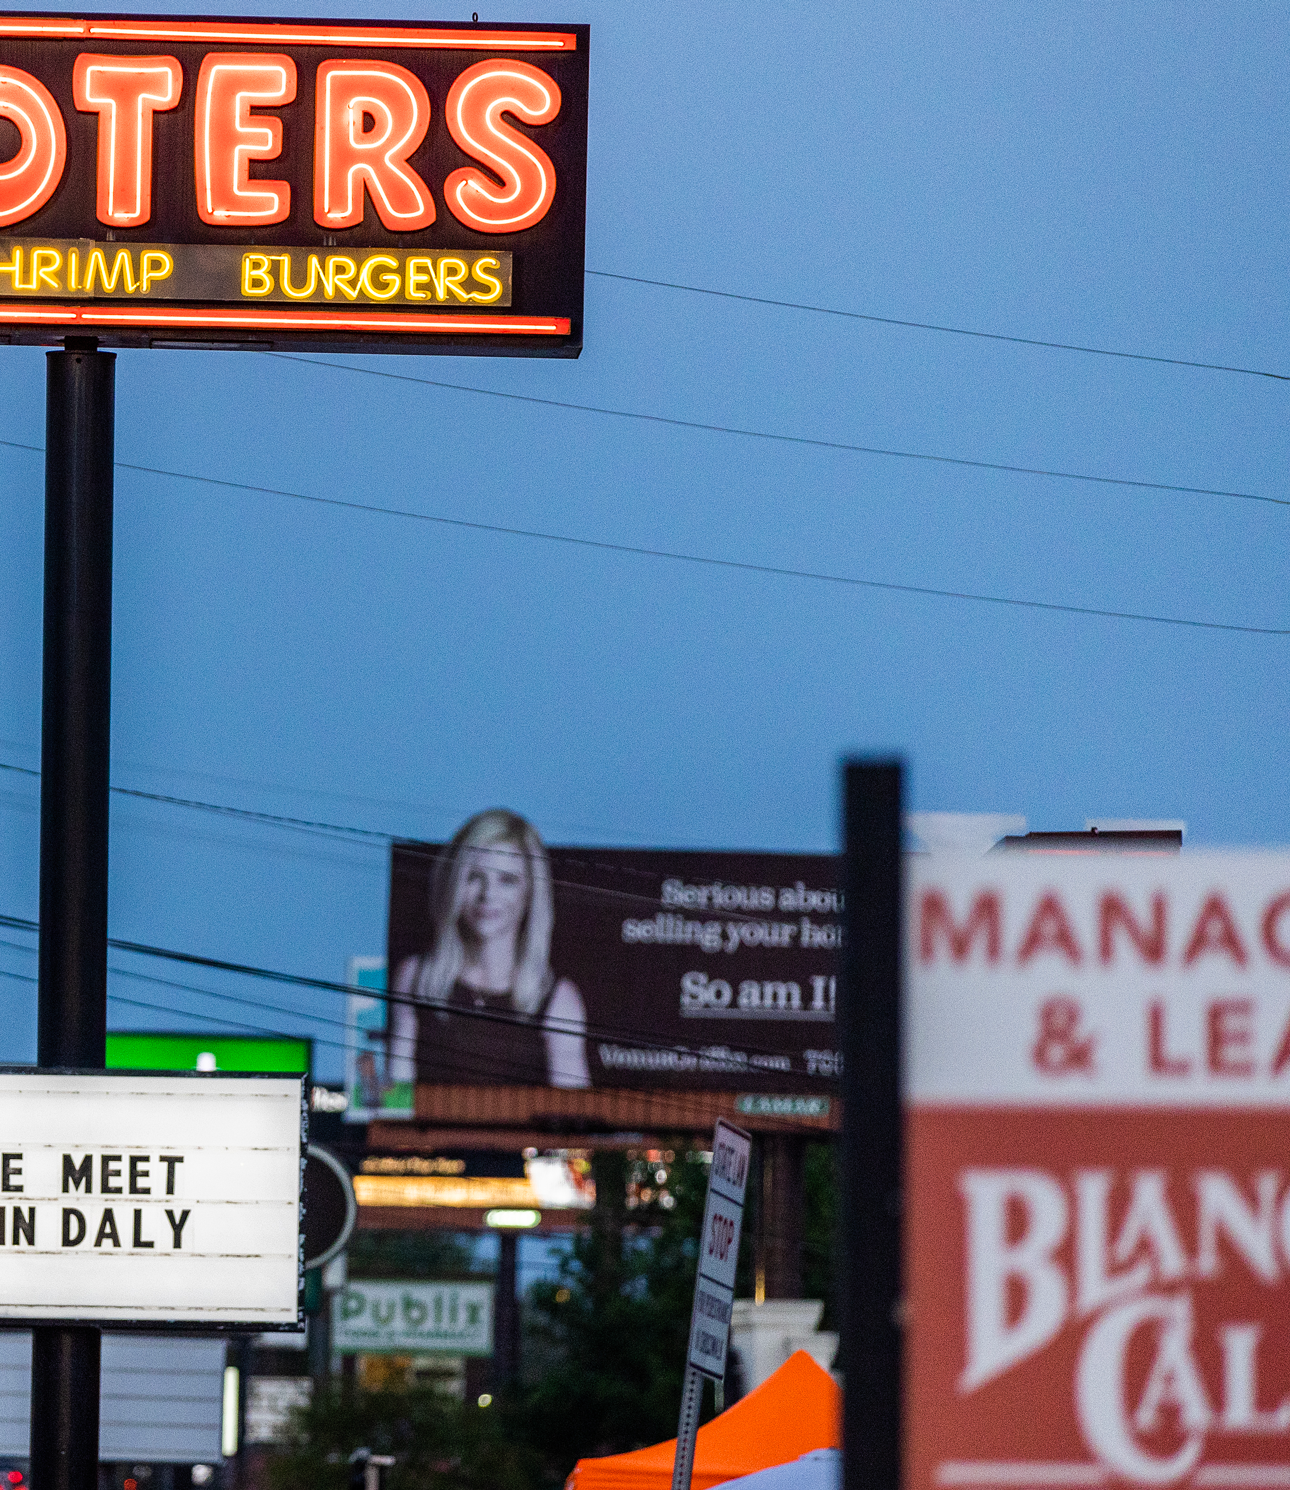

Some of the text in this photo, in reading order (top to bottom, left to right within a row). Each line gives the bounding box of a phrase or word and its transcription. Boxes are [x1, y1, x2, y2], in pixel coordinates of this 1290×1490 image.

[241, 251, 504, 302] BURGERS
[662, 878, 776, 912] Serious
[622, 912, 724, 953] selling
[724, 921, 798, 954] your
[680, 971, 732, 1008] So
[738, 979, 801, 1009] am
[1031, 998, 1097, 1077] &
[62, 1153, 184, 1195] MEET
[61, 1207, 191, 1249] DALY
[710, 1212, 735, 1262] STOP
[957, 1166, 1290, 1396] BLAN
[341, 1289, 482, 1326] Publix
